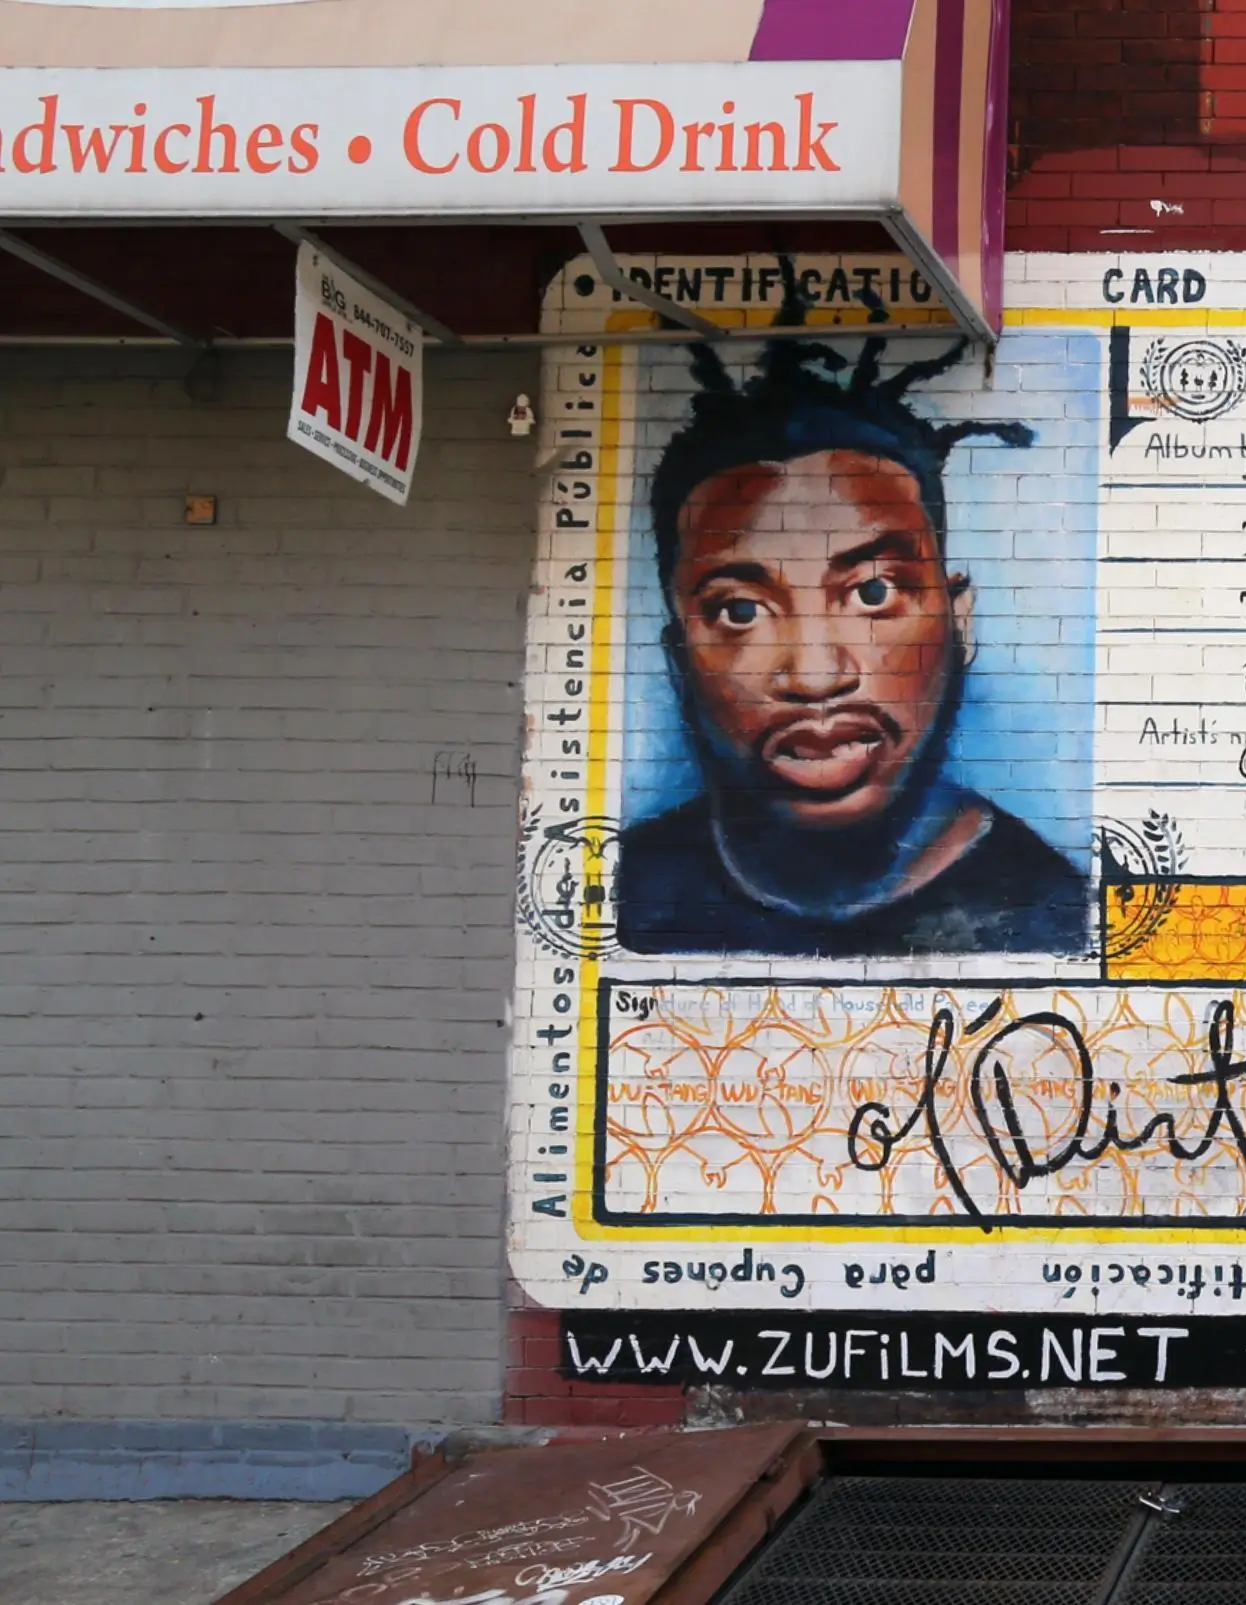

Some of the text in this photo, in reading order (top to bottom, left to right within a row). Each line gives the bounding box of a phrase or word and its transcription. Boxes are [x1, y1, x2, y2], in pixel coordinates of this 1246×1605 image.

[0, 91, 841, 173] dwiches Cold Drink
[1102, 268, 1206, 304] CARD
[301, 311, 413, 473] ATM
[1145, 432, 1232, 458] Album
[543, 561, 588, 844] Asistencia
[1138, 715, 1218, 746] Artist's
[531, 966, 575, 1218] Alimentos
[562, 1253, 609, 1295] de
[844, 1250, 936, 1290] para
